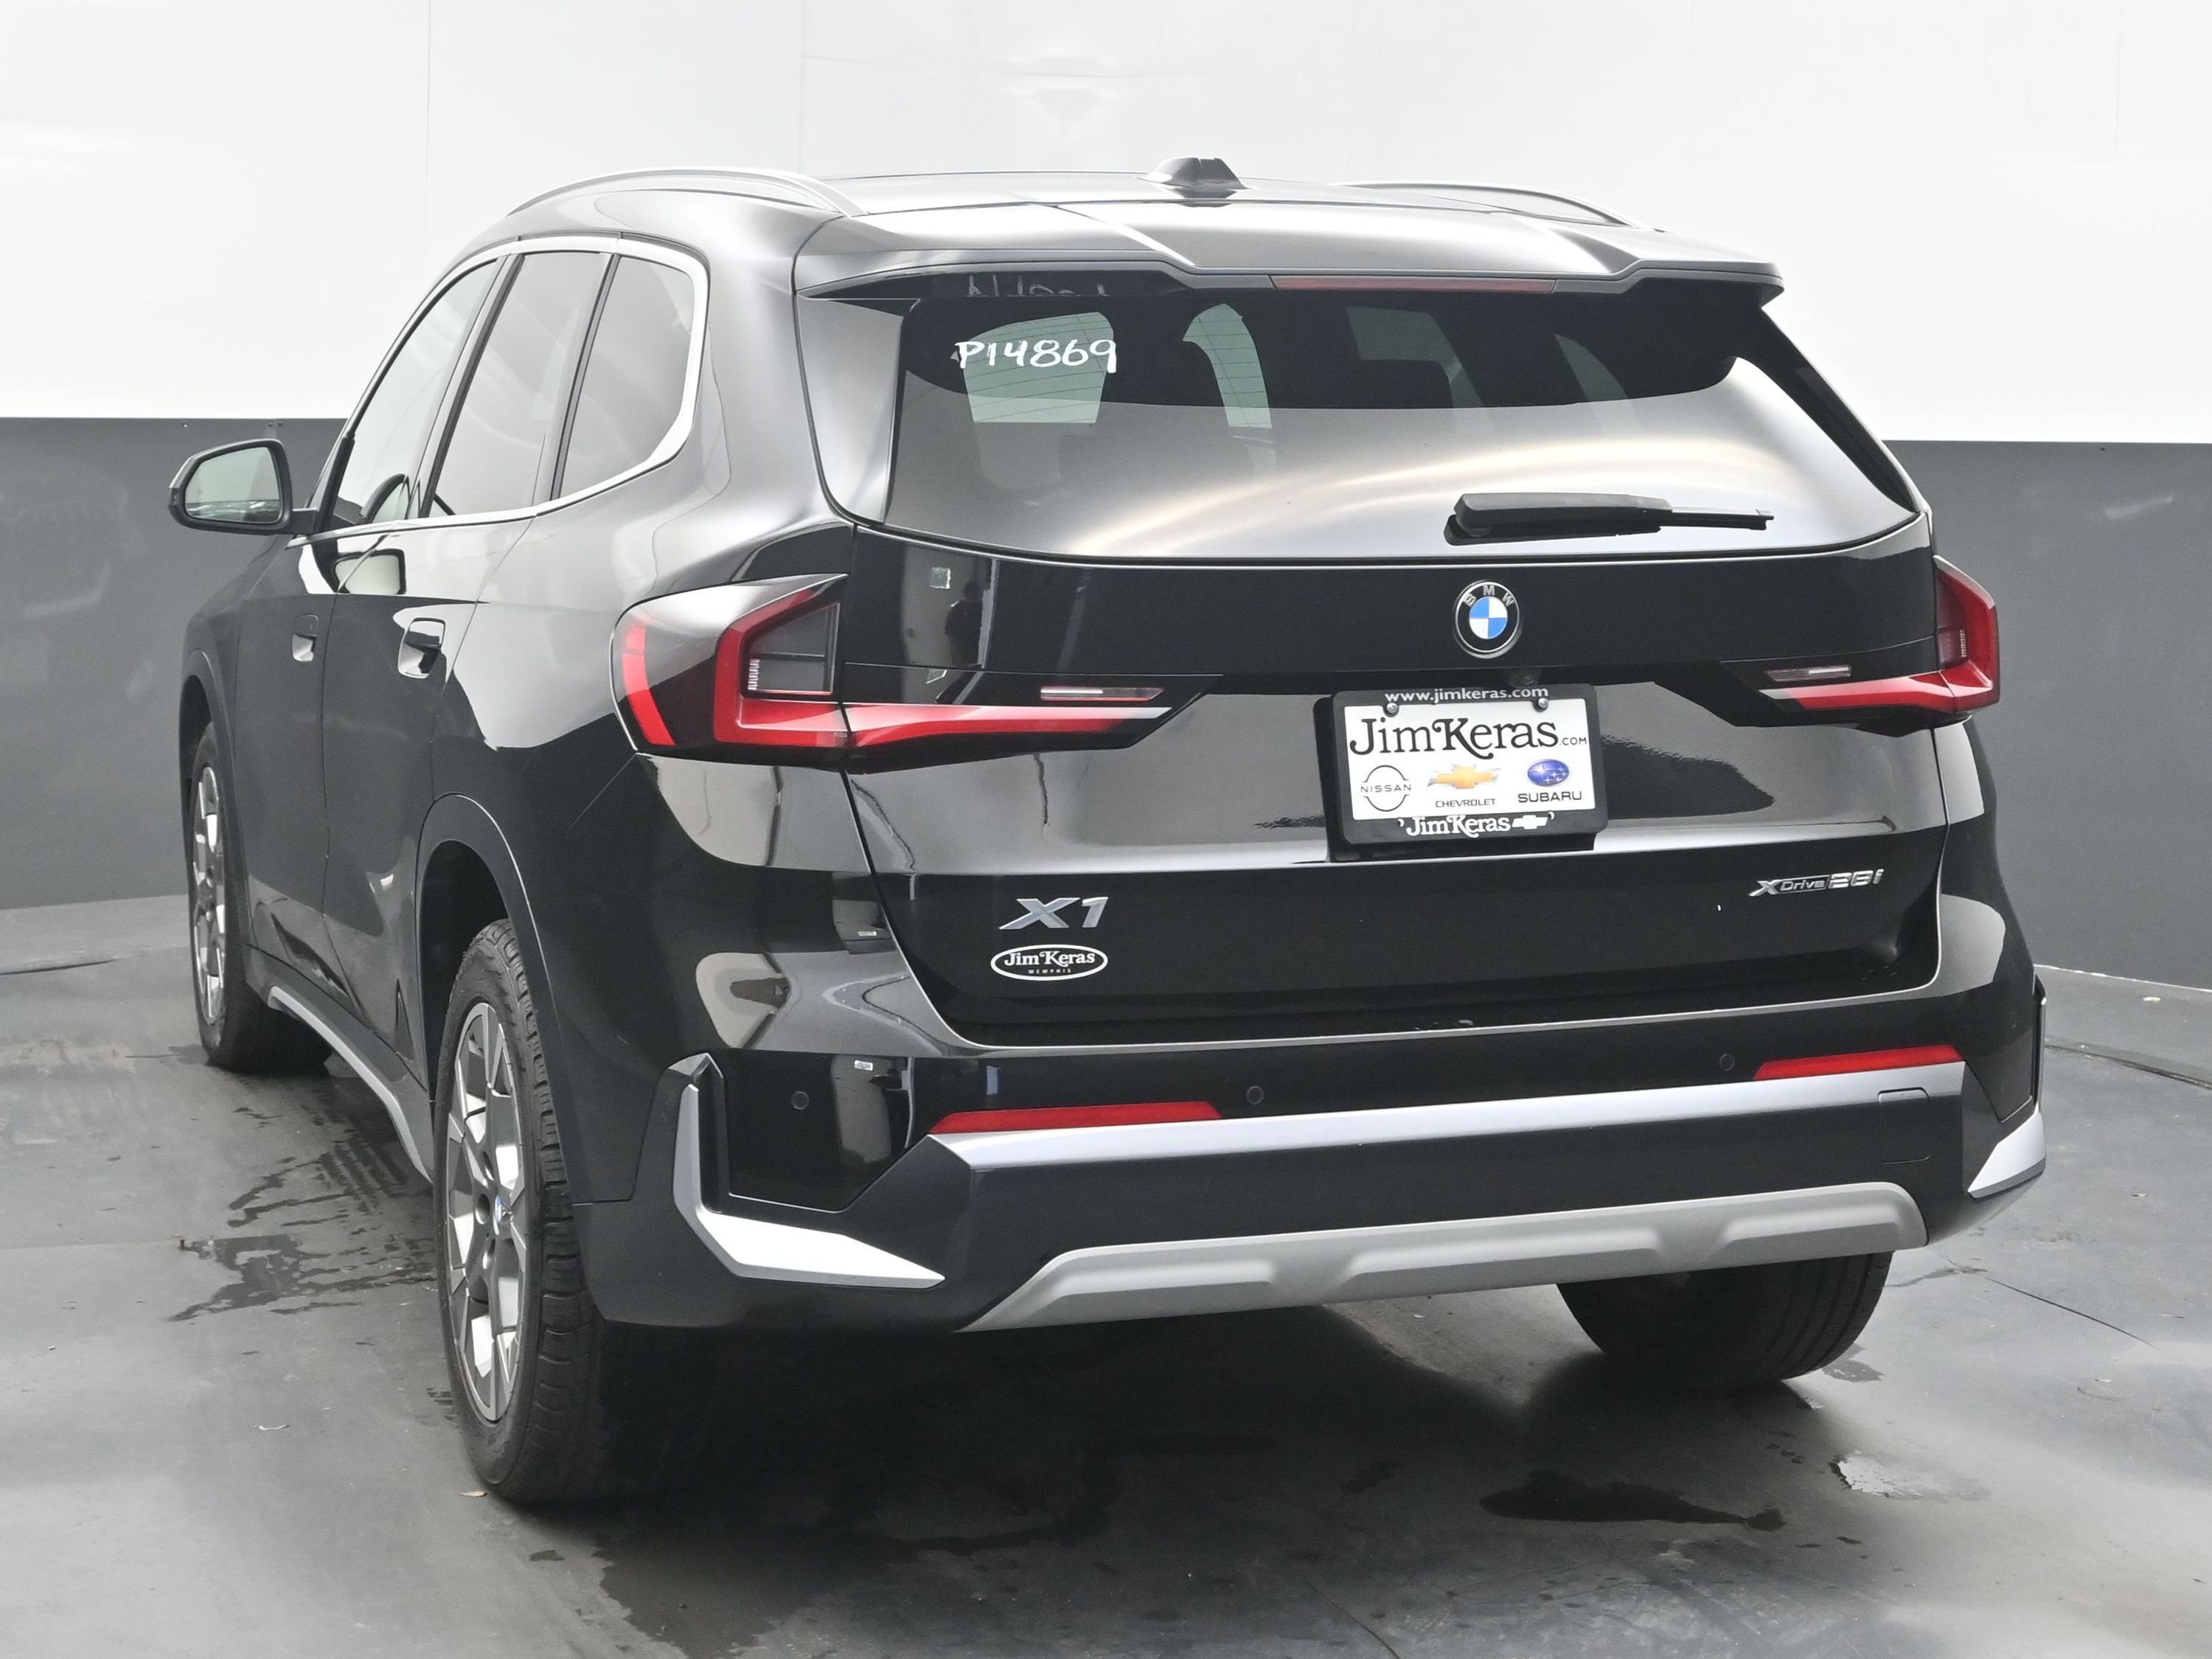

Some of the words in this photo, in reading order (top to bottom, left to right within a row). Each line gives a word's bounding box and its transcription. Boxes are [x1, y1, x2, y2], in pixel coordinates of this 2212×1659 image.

[954, 338, 1116, 374] P14869
[1385, 686, 1548, 704] www.jimkeras.com
[1360, 783, 1412, 793] NISSAN
[1435, 798, 1496, 808] CHEVROLET
[1517, 790, 1582, 804] SUBARU
[998, 896, 1109, 931] X1
